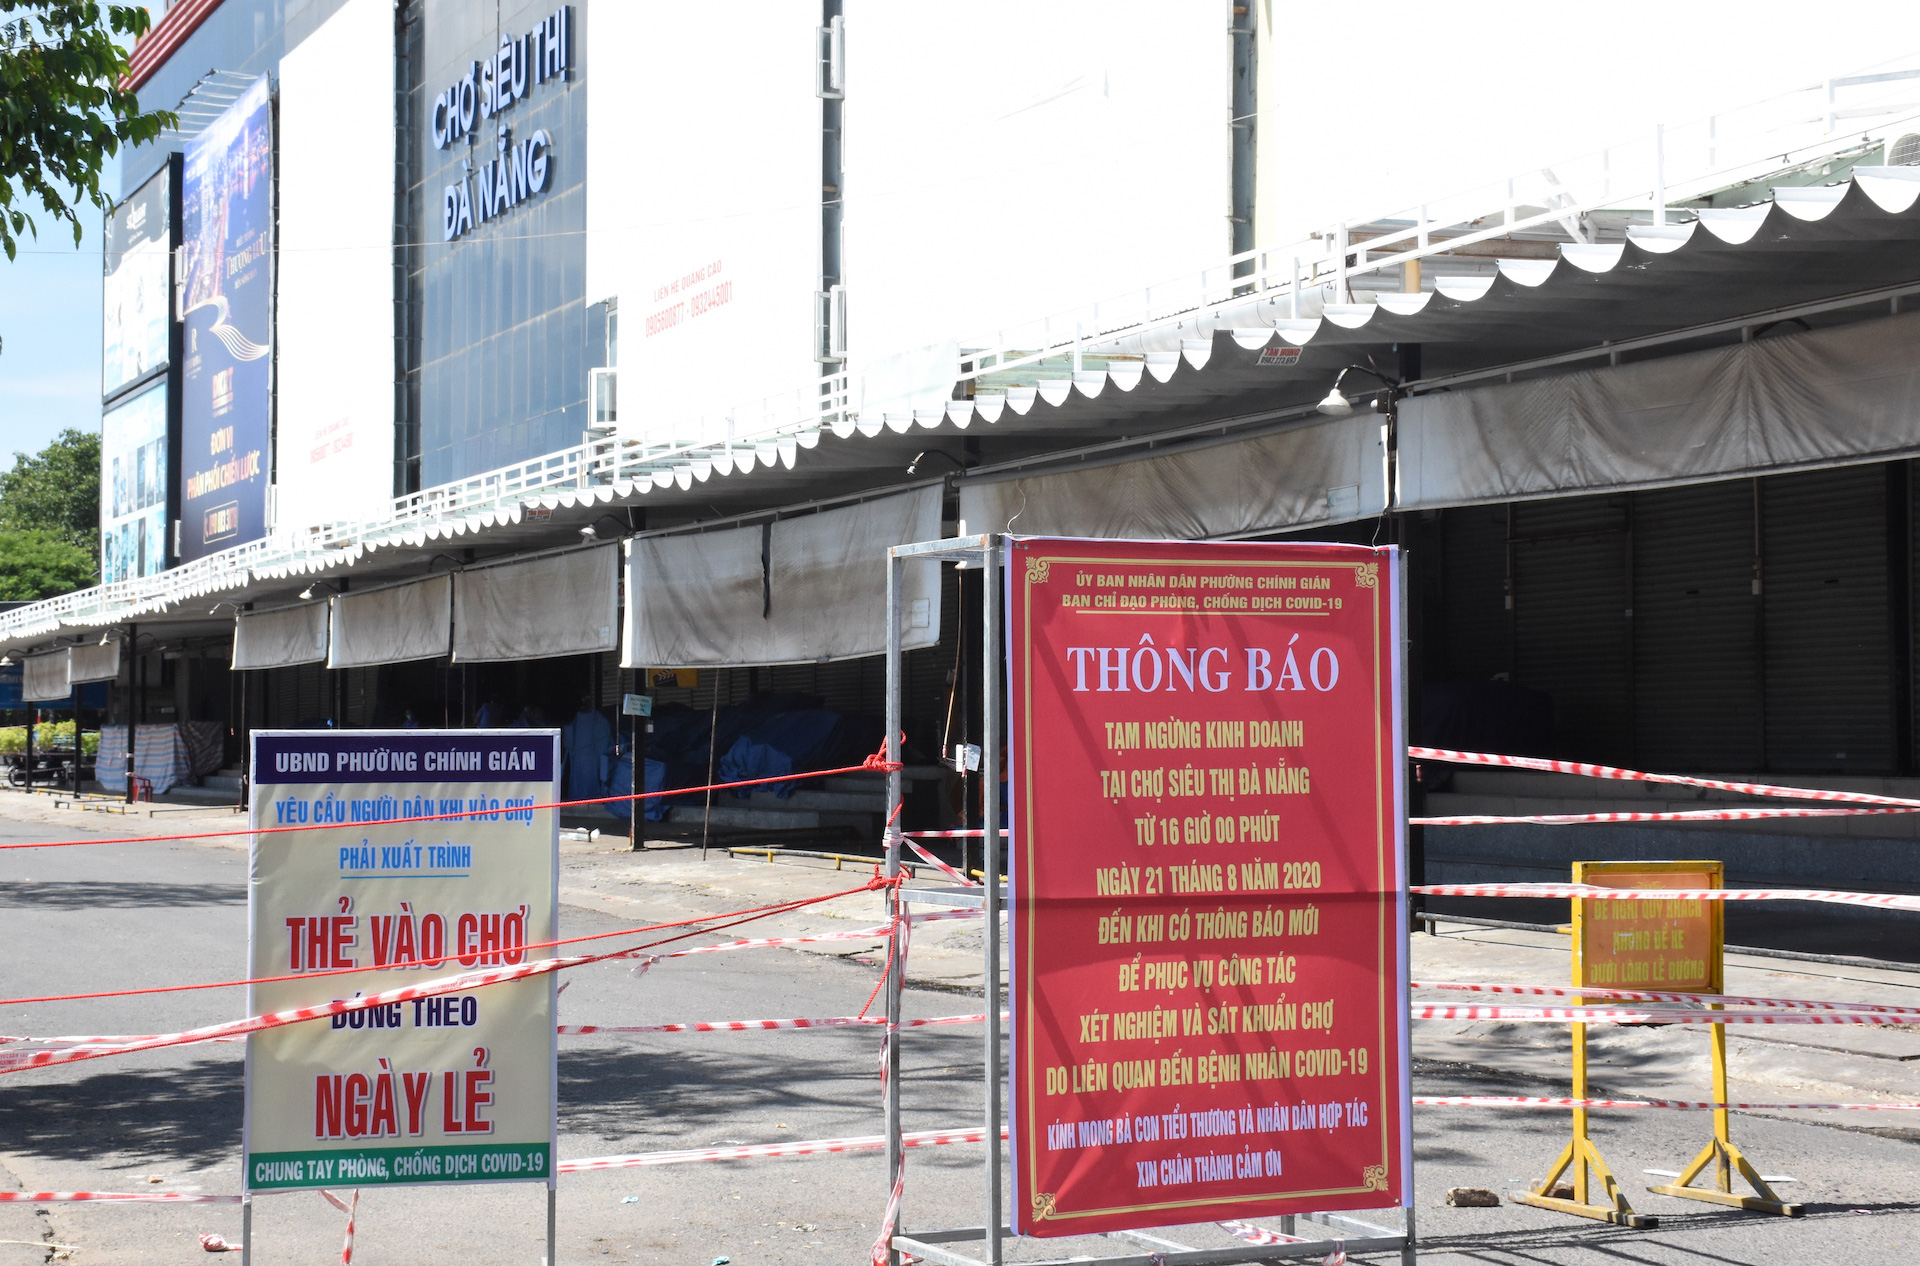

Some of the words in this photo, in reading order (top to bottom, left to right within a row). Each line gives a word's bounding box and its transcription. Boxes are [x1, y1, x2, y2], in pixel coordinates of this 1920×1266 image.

[432, 60, 479, 150] CHỢ
[480, 33, 530, 119] SIÊU
[532, 5, 571, 85] THỊ
[443, 158, 474, 242] ĐÀ
[478, 123, 551, 224] NẴNG
[1062, 595, 1091, 607] BAN
[1094, 591, 1117, 608] CHỈ
[1120, 595, 1147, 610] ĐẠO
[1151, 593, 1200, 610] PHÒNG,
[1203, 592, 1248, 609] CHỐNG
[1251, 597, 1282, 611] DỊCH
[1285, 597, 1343, 610] COVID-19
[1076, 570, 1093, 587] ỦY
[1097, 575, 1124, 587] BAN
[1128, 573, 1166, 588] NHÂN
[1169, 574, 1197, 588] DÂN
[1200, 574, 1253, 589] PHƯỜNG
[1257, 575, 1297, 590] CHÍNH
[1302, 575, 1331, 590] GIÁN
[1066, 633, 1232, 693] THÔNG
[1244, 633, 1340, 692] BÁO
[1104, 721, 1140, 755] TẠM
[1145, 715, 1202, 749] NGỪNG
[1205, 721, 1245, 748] KINH
[1249, 720, 1304, 748] DOANH
[275, 752, 330, 773] UBND
[336, 747, 418, 772] PHƯỜNG
[424, 747, 482, 772] CHÍNH
[488, 746, 536, 771] GIÁN
[1100, 770, 1126, 804] TẠI
[1131, 766, 1164, 803] CHỢ
[1168, 763, 1205, 797] SIÊU
[1209, 768, 1235, 801] THỊ
[1238, 762, 1261, 795] ĐÀ
[1265, 757, 1310, 795] NẴNG
[275, 796, 308, 824] YÊU
[313, 791, 346, 823] CẦU
[350, 794, 398, 822] NGƯỜI
[402, 795, 435, 821] DÂN
[440, 799, 463, 821] KHI
[468, 793, 500, 821] VÀO
[505, 795, 535, 827] CHỢ
[1134, 812, 1157, 846] TỪ
[1160, 817, 1180, 845] 16
[1183, 809, 1211, 844] GIỜ
[1215, 816, 1235, 843] 00
[1239, 809, 1280, 842] PHÚT
[340, 838, 376, 869] PHẢI
[381, 839, 423, 869] XUẤT
[427, 840, 471, 868] TRÌNH
[1096, 861, 1140, 896] NGÀY
[1145, 866, 1164, 894] 21
[1168, 859, 1223, 893] THÁNG
[1227, 863, 1238, 891] 8
[1241, 857, 1279, 890] NĂM
[1283, 861, 1322, 889] 2020
[286, 896, 355, 969] THẺ
[370, 902, 444, 967] VÀO
[1098, 907, 1132, 944] ĐẾN
[1136, 914, 1165, 942] KHI
[1168, 908, 1191, 941] CÓ
[1195, 906, 1248, 939] THÔNG
[1252, 904, 1284, 937] BÁO
[1288, 902, 1319, 936] MỚI
[1118, 952, 1142, 992] ĐỂ
[1144, 961, 1188, 995] PHỤC
[1192, 960, 1214, 993] VỤ
[1218, 953, 1262, 986] CÔNG
[1266, 951, 1296, 984] TÁC
[411, 996, 478, 1027] THEO
[1079, 1008, 1109, 1043] XÉT
[1113, 1004, 1178, 1044] NGHIỆM
[1181, 1002, 1203, 1036] VÀ
[1207, 1001, 1238, 1034] SÁT
[1242, 992, 1297, 1033] KHUẨN
[1301, 999, 1334, 1034] CHỢ
[315, 1058, 429, 1138] NGÀY
[443, 1047, 491, 1132] LẺ
[1046, 1065, 1068, 1096] DO
[1072, 1058, 1108, 1093] LIÊN
[1112, 1059, 1156, 1093] QUAN
[1160, 1048, 1193, 1086] ĐẾN
[1197, 1049, 1241, 1089] BỆNH
[1245, 1046, 1291, 1080] NHÂN
[1295, 1047, 1368, 1078] COVID-19
[1047, 1118, 1076, 1151] KÍNH
[1078, 1118, 1113, 1148] MONG
[1116, 1112, 1133, 1144] BÀ
[1135, 1115, 1160, 1143] CON
[1161, 1103, 1188, 1140] TIỂU
[1190, 1108, 1236, 1138] THƯƠNG
[1238, 1103, 1254, 1134] VÀ
[1256, 1101, 1290, 1133] NHÂN
[1292, 1100, 1316, 1131] DÂN
[1319, 1101, 1342, 1134] HỢP
[1345, 1097, 1368, 1127] TÁC
[255, 1161, 303, 1182] CHUNG
[307, 1159, 335, 1180] TAY
[338, 1153, 390, 1180] PHÒNG,
[394, 1148, 441, 1176] CHỐNG
[445, 1153, 478, 1179] DỊCH
[481, 1151, 544, 1174] COVID-19
[1136, 1160, 1158, 1188] XIN
[1160, 1153, 1193, 1186] CHÂN
[1194, 1150, 1233, 1182] THÀNH
[1236, 1144, 1263, 1179] CẢM
[1265, 1148, 1282, 1176] ƠN
